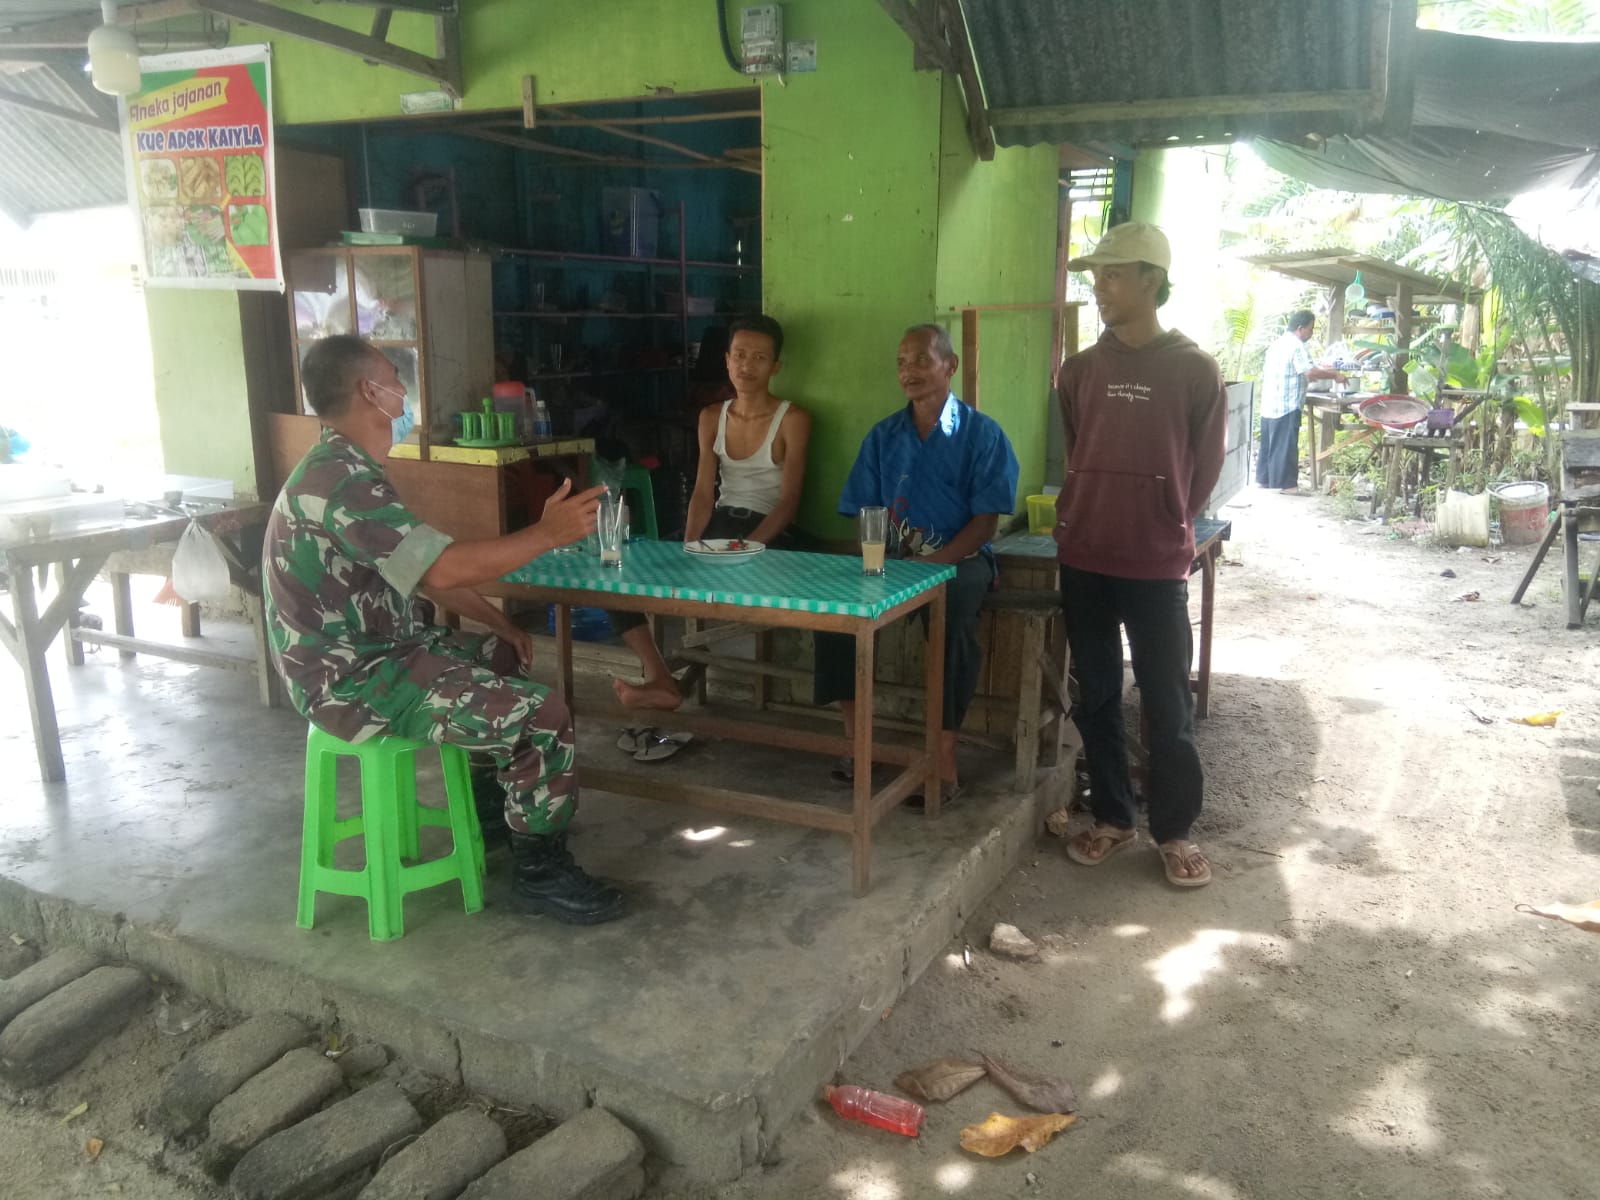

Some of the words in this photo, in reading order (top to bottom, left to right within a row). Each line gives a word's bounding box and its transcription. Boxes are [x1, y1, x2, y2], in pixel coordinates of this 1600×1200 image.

[130, 97, 169, 122] Aneka
[172, 81, 222, 114] jajanan
[208, 125, 263, 149] KAIYLA
